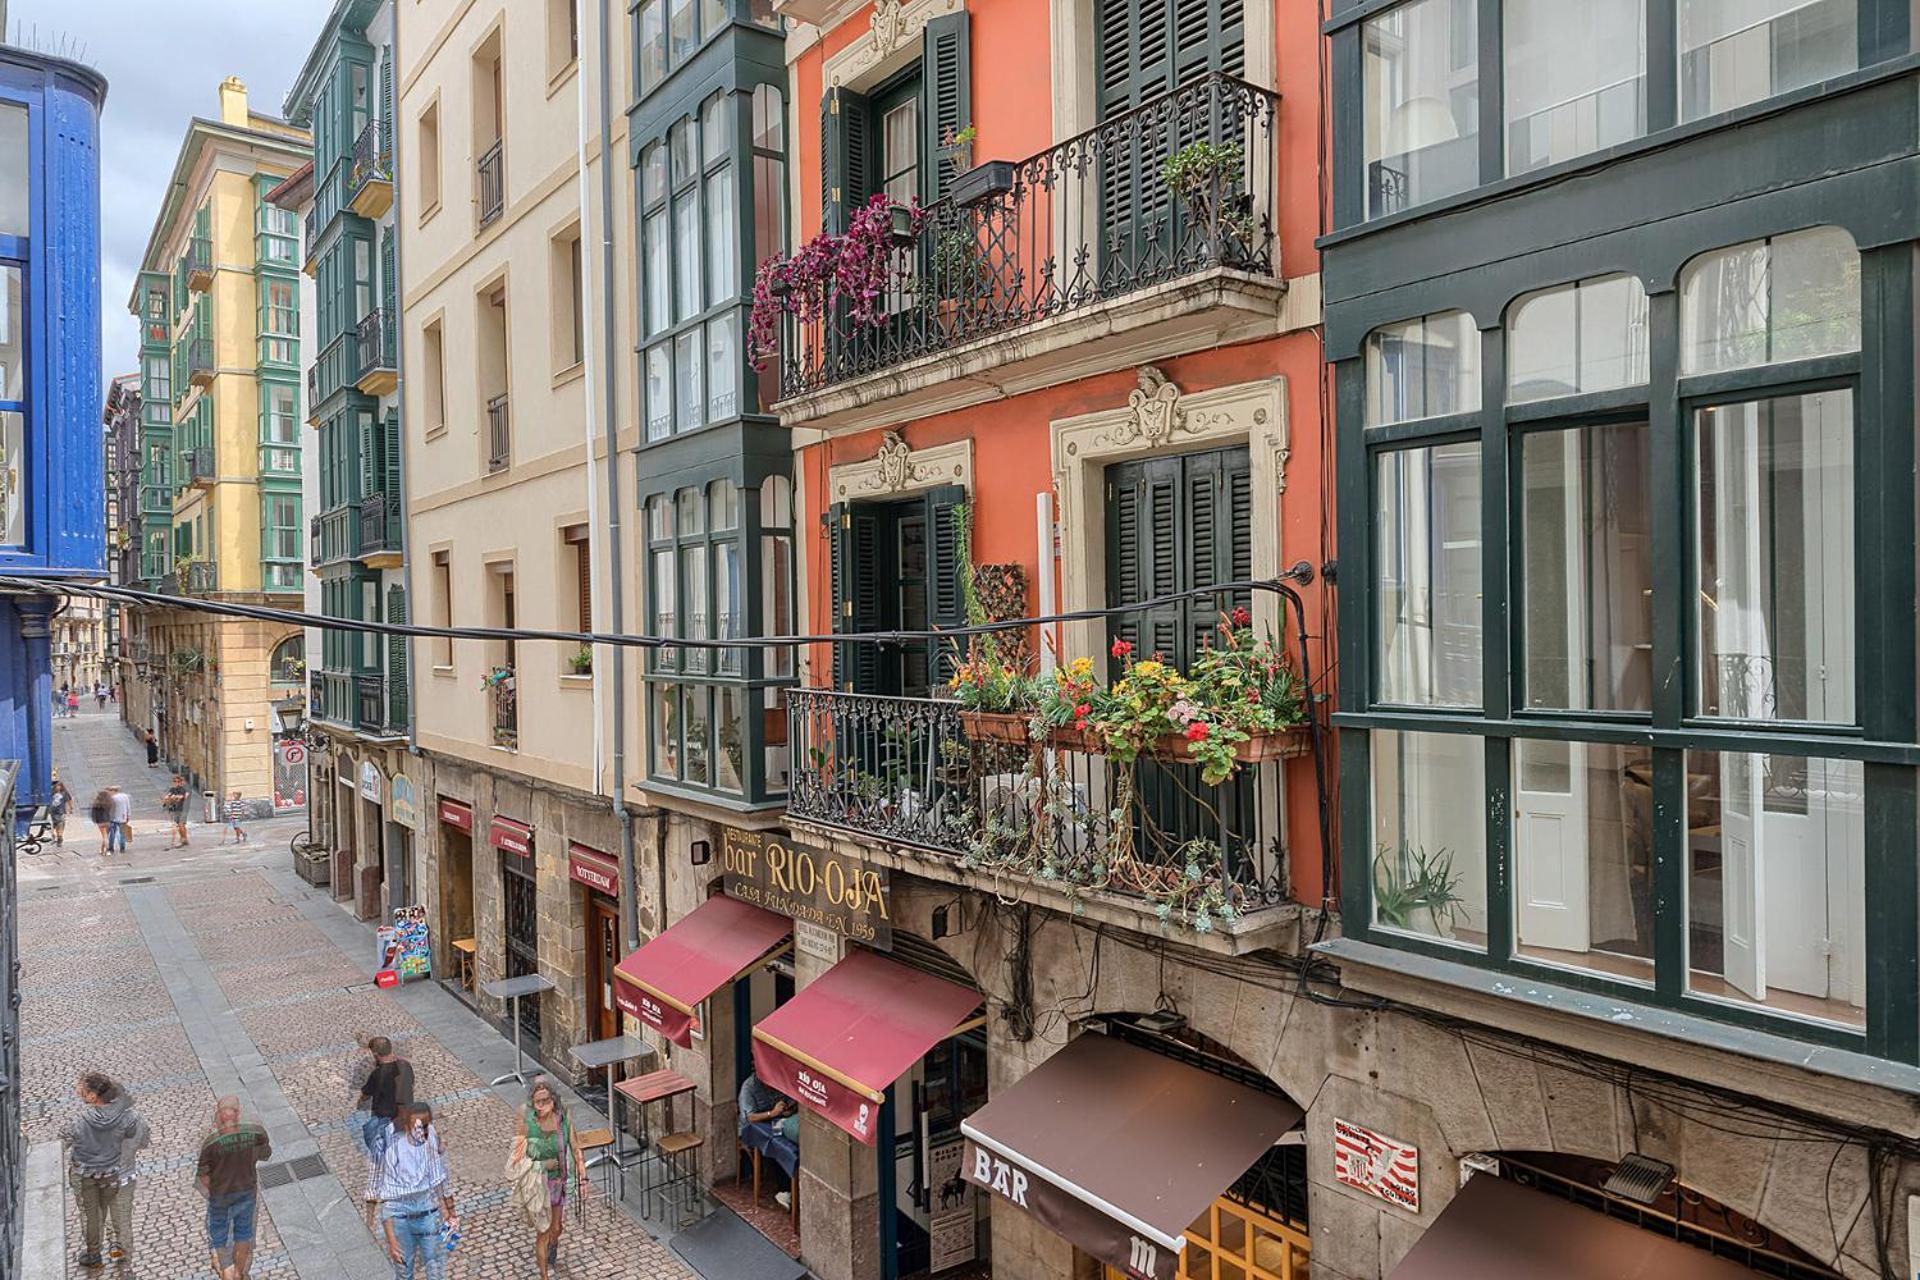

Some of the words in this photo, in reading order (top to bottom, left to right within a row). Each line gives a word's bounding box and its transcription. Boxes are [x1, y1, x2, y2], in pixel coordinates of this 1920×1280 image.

[724, 833, 756, 878] bar
[766, 842, 889, 920] RIO-OJA
[735, 882, 760, 902] CASA
[764, 891, 824, 924] FUNDADA
[826, 913, 849, 936] EN
[851, 922, 875, 940] 1959
[973, 1146, 1029, 1209] BAR
